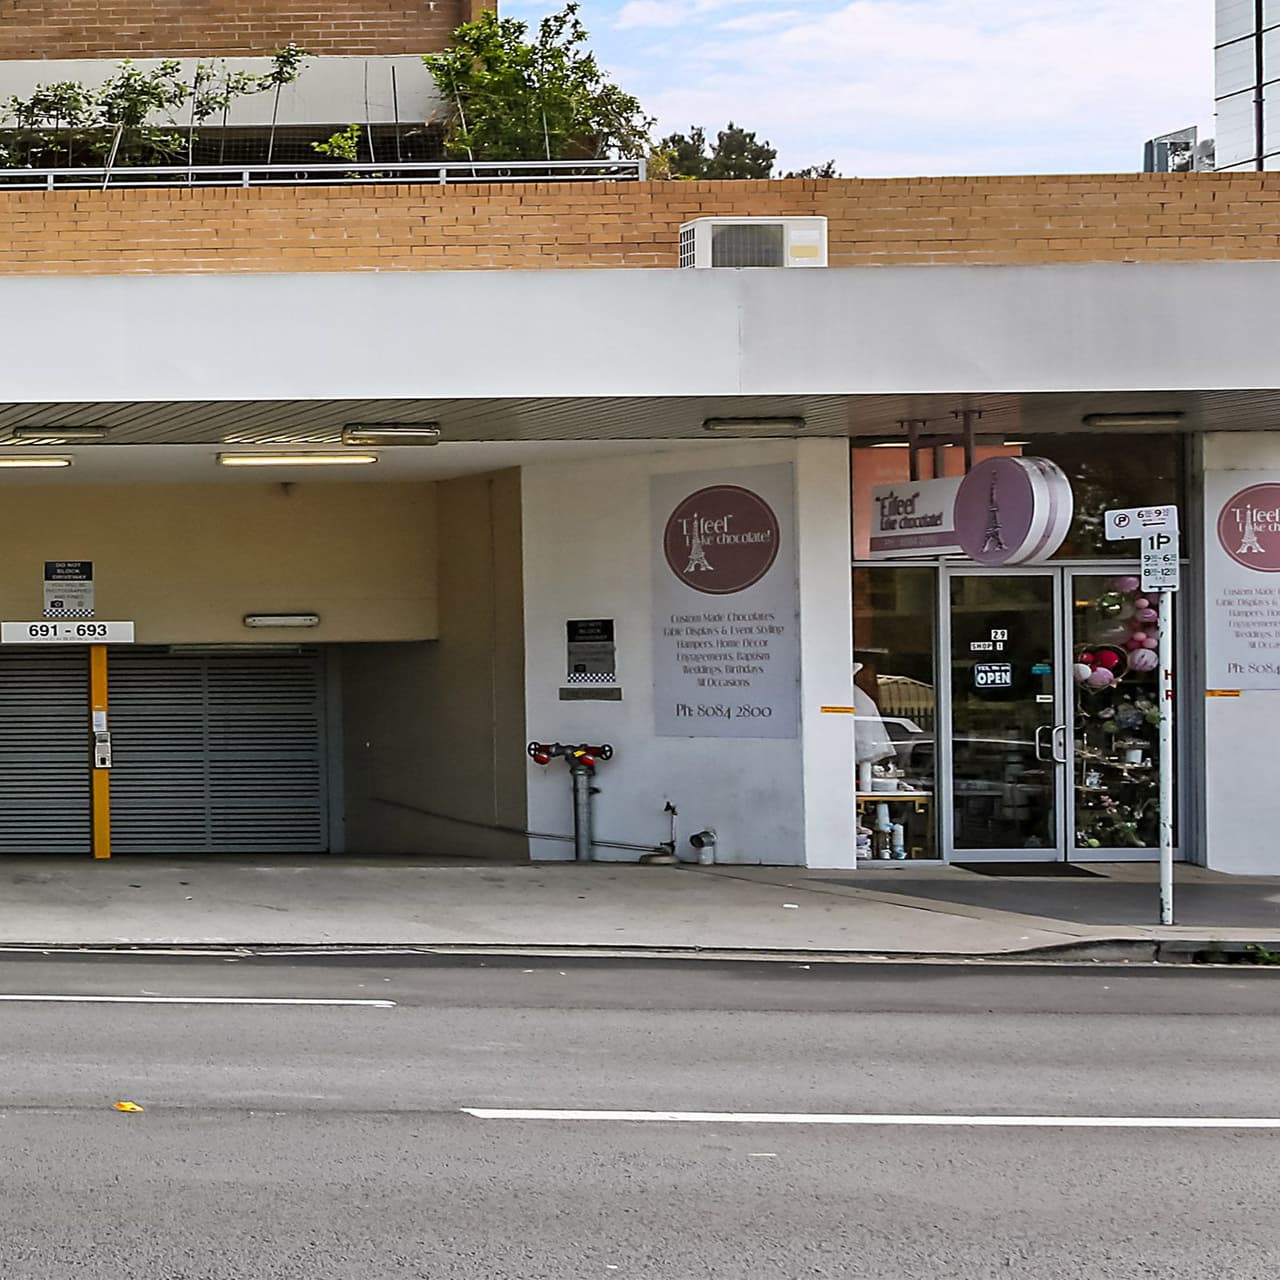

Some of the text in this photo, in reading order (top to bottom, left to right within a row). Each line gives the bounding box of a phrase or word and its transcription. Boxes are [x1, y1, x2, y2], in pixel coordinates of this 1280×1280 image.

[716, 529, 771, 545] chocolate!
[1148, 534, 1171, 550] 1P
[28, 624, 58, 637] 691
[76, 624, 108, 637] 693
[976, 672, 1011, 685] OPEN
[697, 703, 731, 720] 8084
[736, 703, 772, 718] 2800
